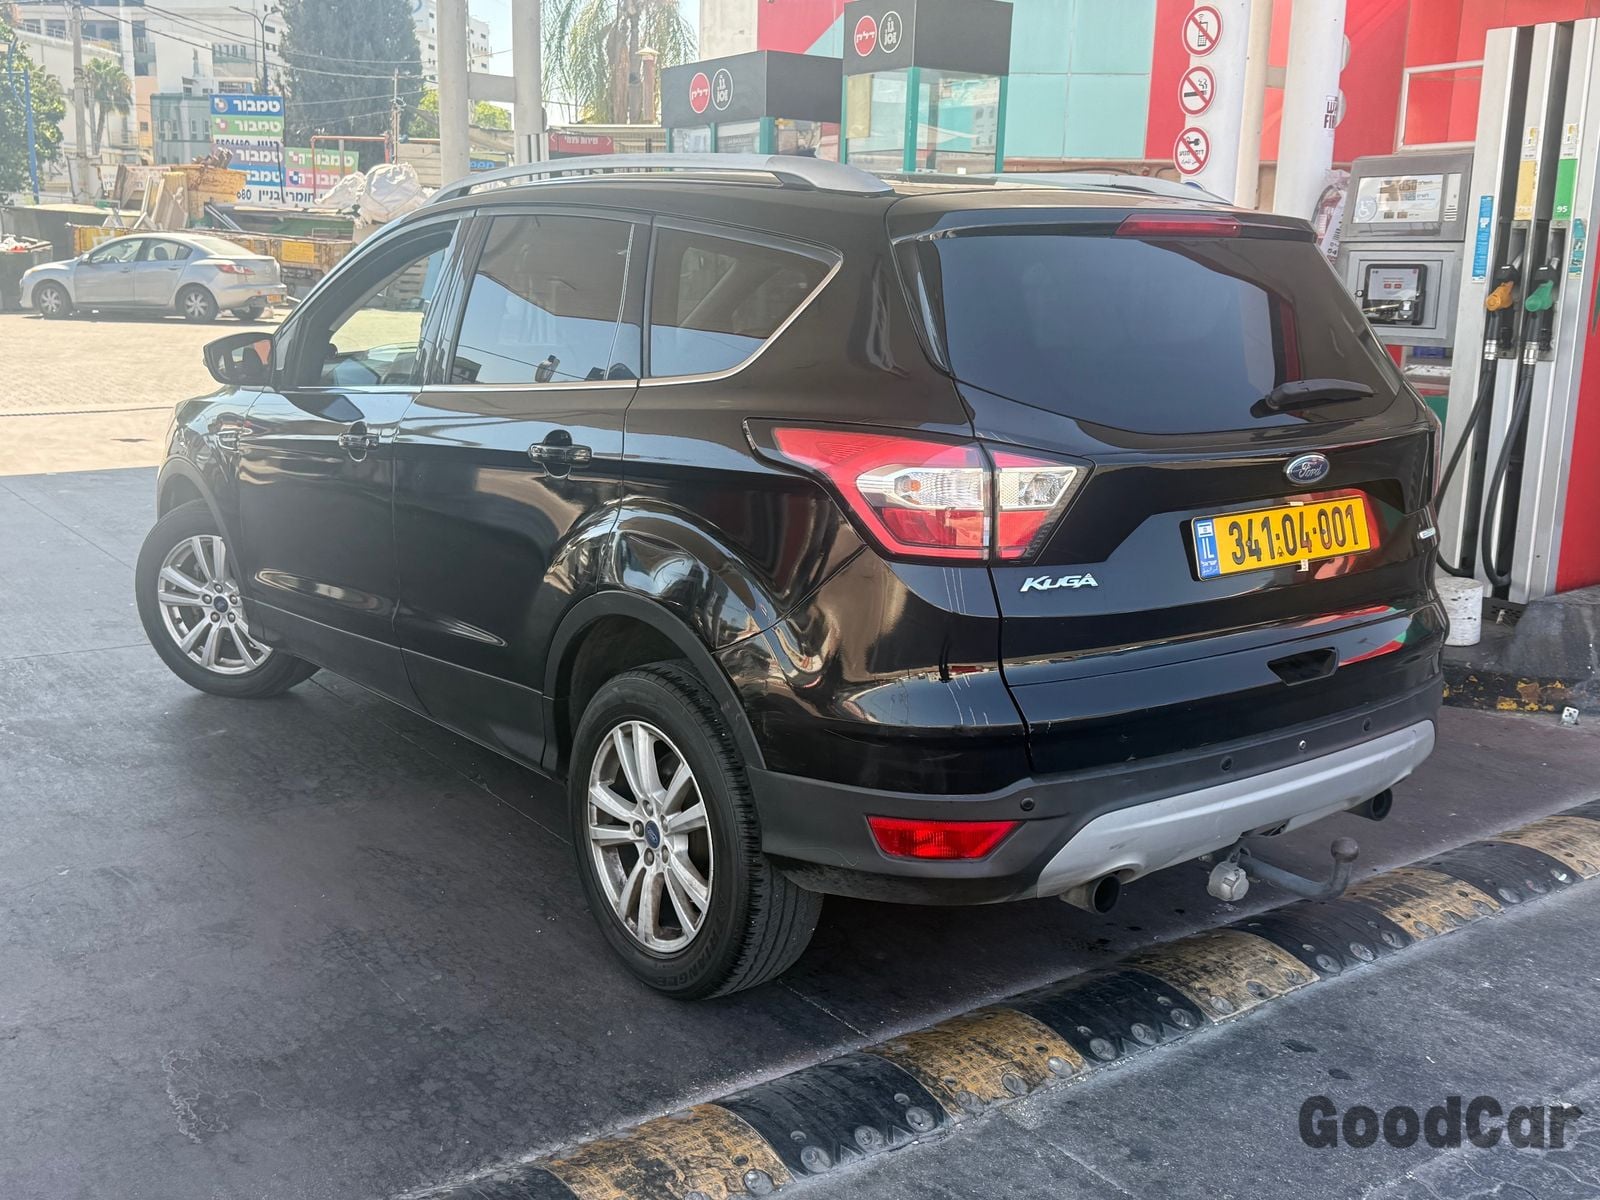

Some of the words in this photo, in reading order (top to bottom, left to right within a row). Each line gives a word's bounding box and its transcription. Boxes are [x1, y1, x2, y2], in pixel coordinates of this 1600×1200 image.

[232, 99, 281, 113] טמבור
[234, 119, 282, 133] טמבור
[236, 149, 284, 163] טמבור
[246, 169, 284, 183] טמבו
[258, 189, 281, 202] בניין
[1557, 205, 1568, 213] 95
[1298, 462, 1323, 478] Ford
[1202, 537, 1215, 559] IL
[1020, 573, 1099, 592] KUGA
